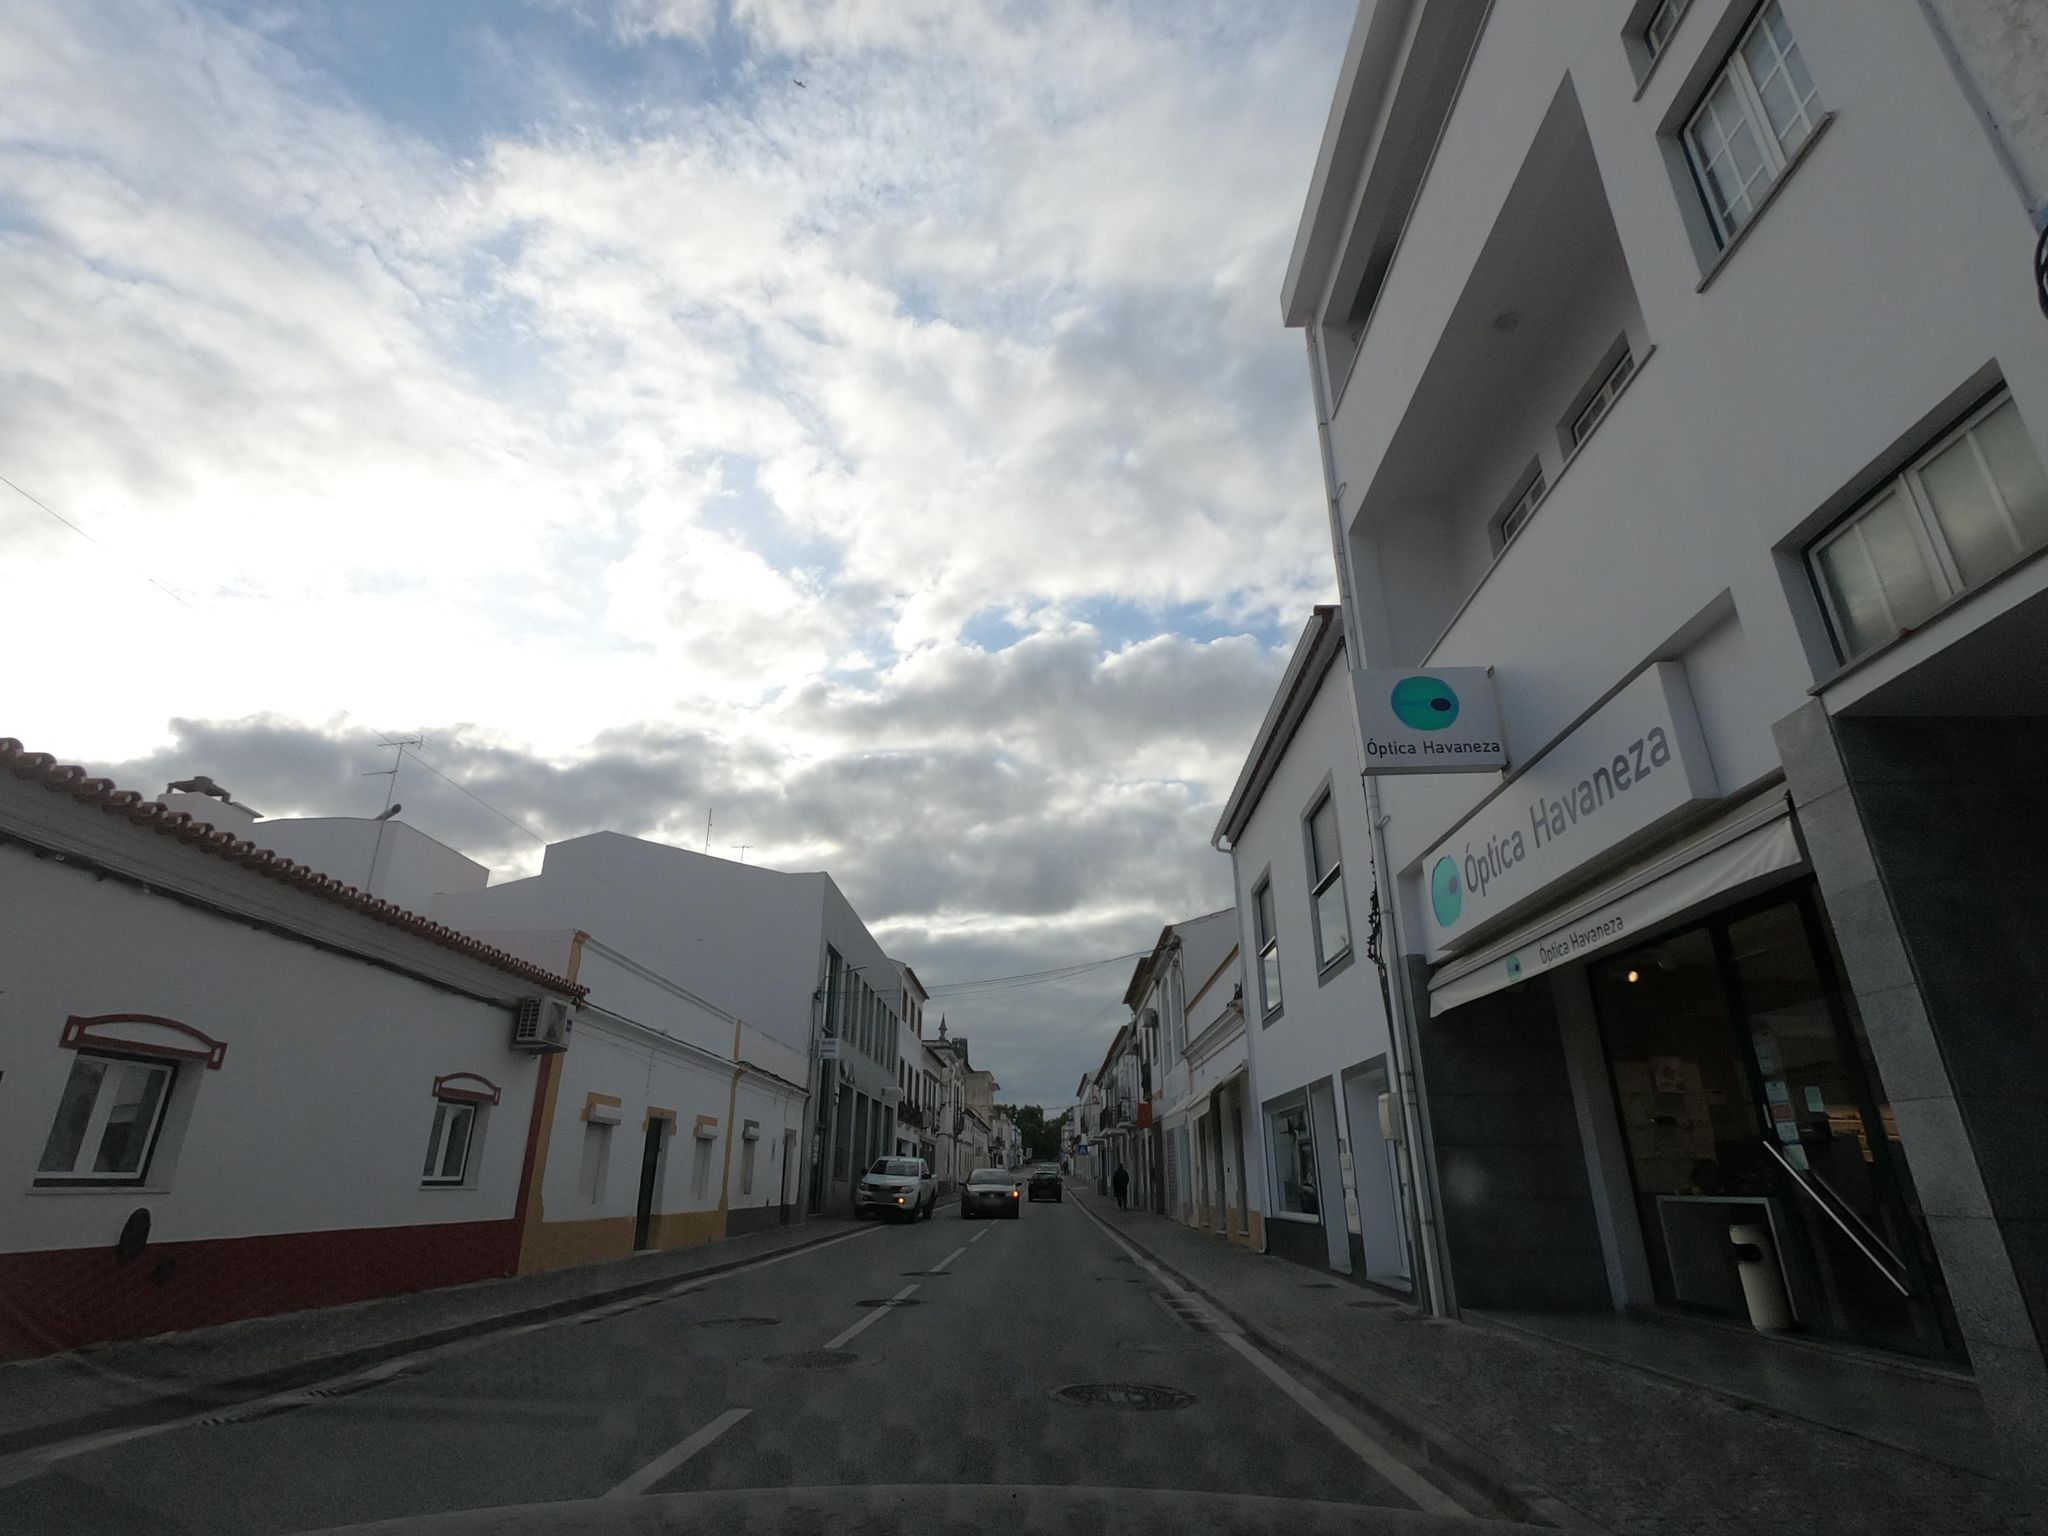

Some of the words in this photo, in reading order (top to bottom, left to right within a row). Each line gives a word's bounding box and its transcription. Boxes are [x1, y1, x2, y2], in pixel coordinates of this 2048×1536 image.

[1367, 738, 1416, 758] Óptica
[1423, 740, 1500, 754] Havaneza
[1464, 830, 1526, 897] Óptica
[1530, 726, 1671, 849] Havaneza
[1569, 916, 1624, 951] Havaneza
